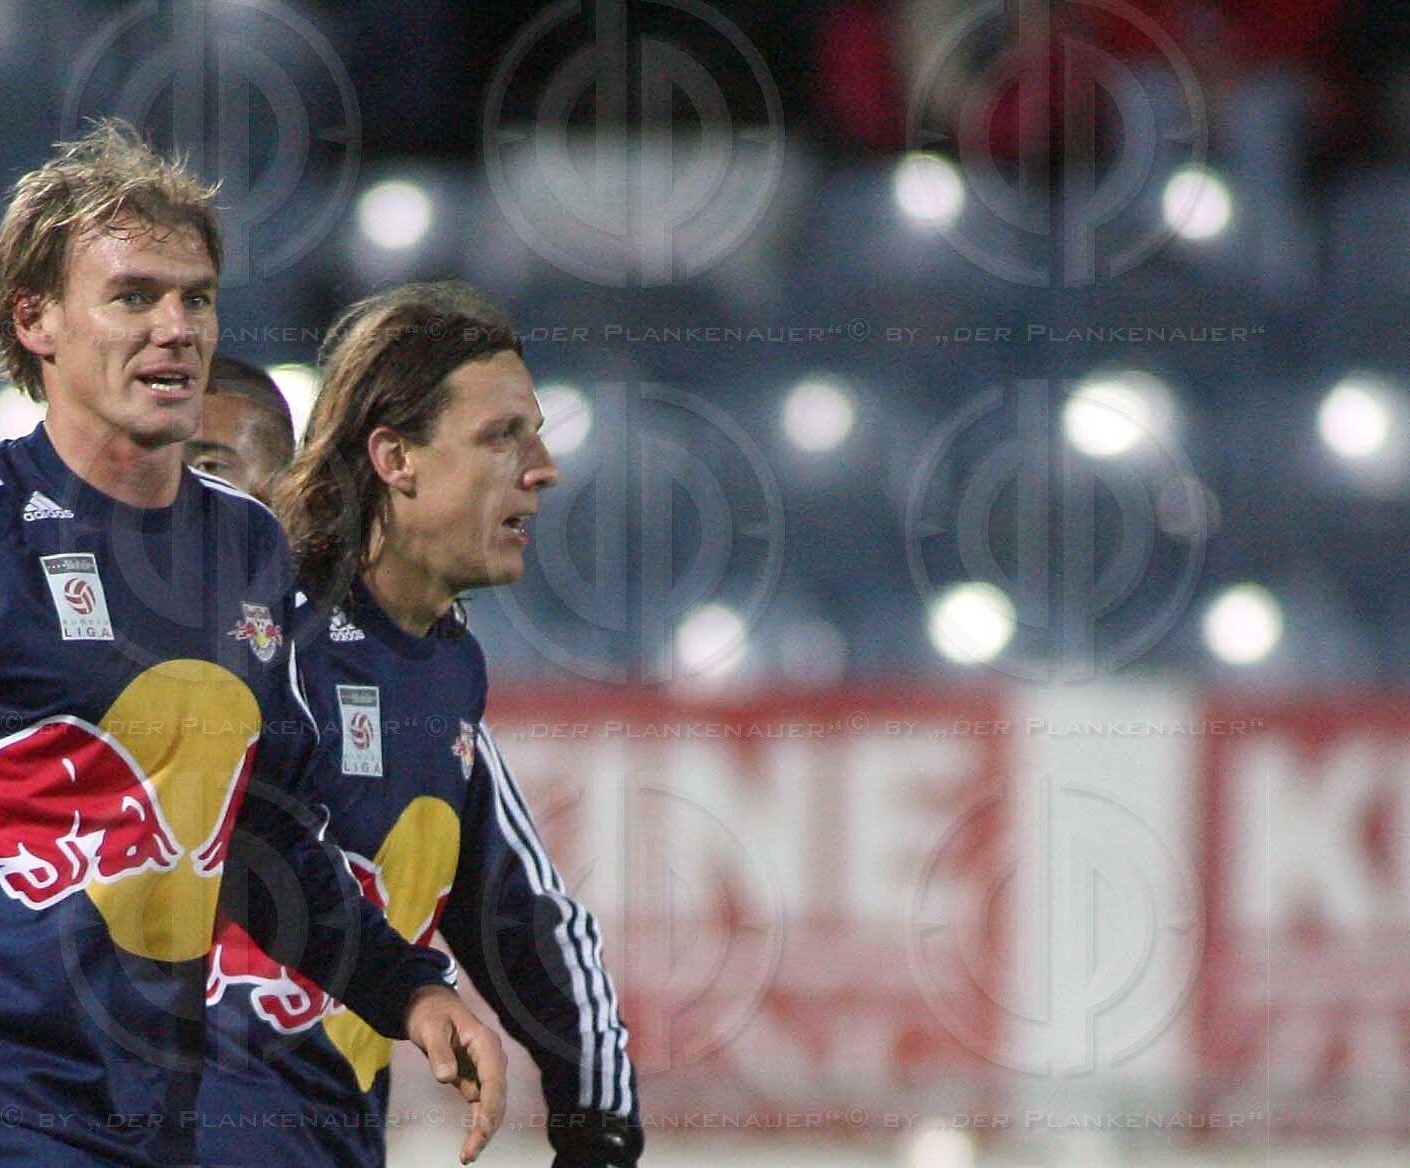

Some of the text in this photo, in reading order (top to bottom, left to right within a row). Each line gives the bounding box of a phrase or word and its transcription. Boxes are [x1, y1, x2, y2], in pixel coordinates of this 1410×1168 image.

[23, 509, 74, 522] adidas
[64, 627, 111, 638] LIGA
[343, 760, 382, 773] LIGA
